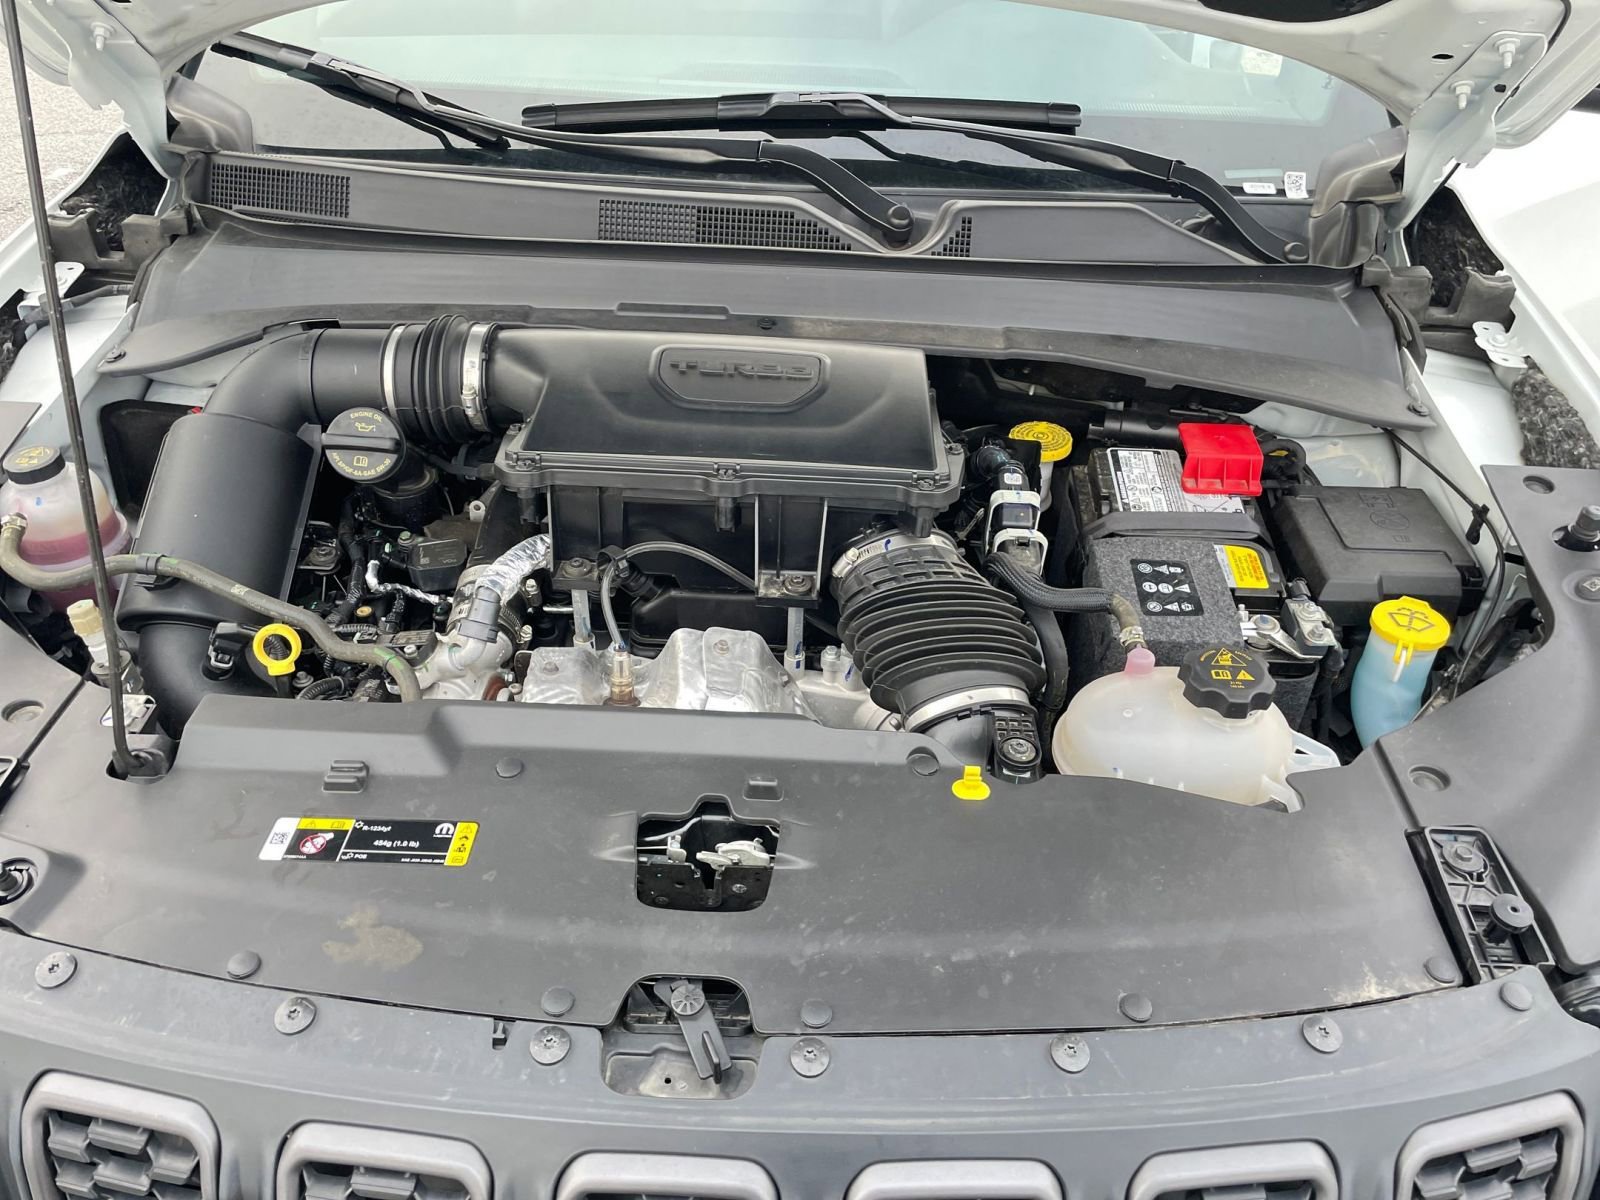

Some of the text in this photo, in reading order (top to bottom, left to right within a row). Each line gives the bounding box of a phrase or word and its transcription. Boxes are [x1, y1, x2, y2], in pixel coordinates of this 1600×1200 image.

[669, 360, 814, 381] TURBO
[350, 411, 383, 422] ENGINE OIL
[373, 839, 393, 848] 454g
